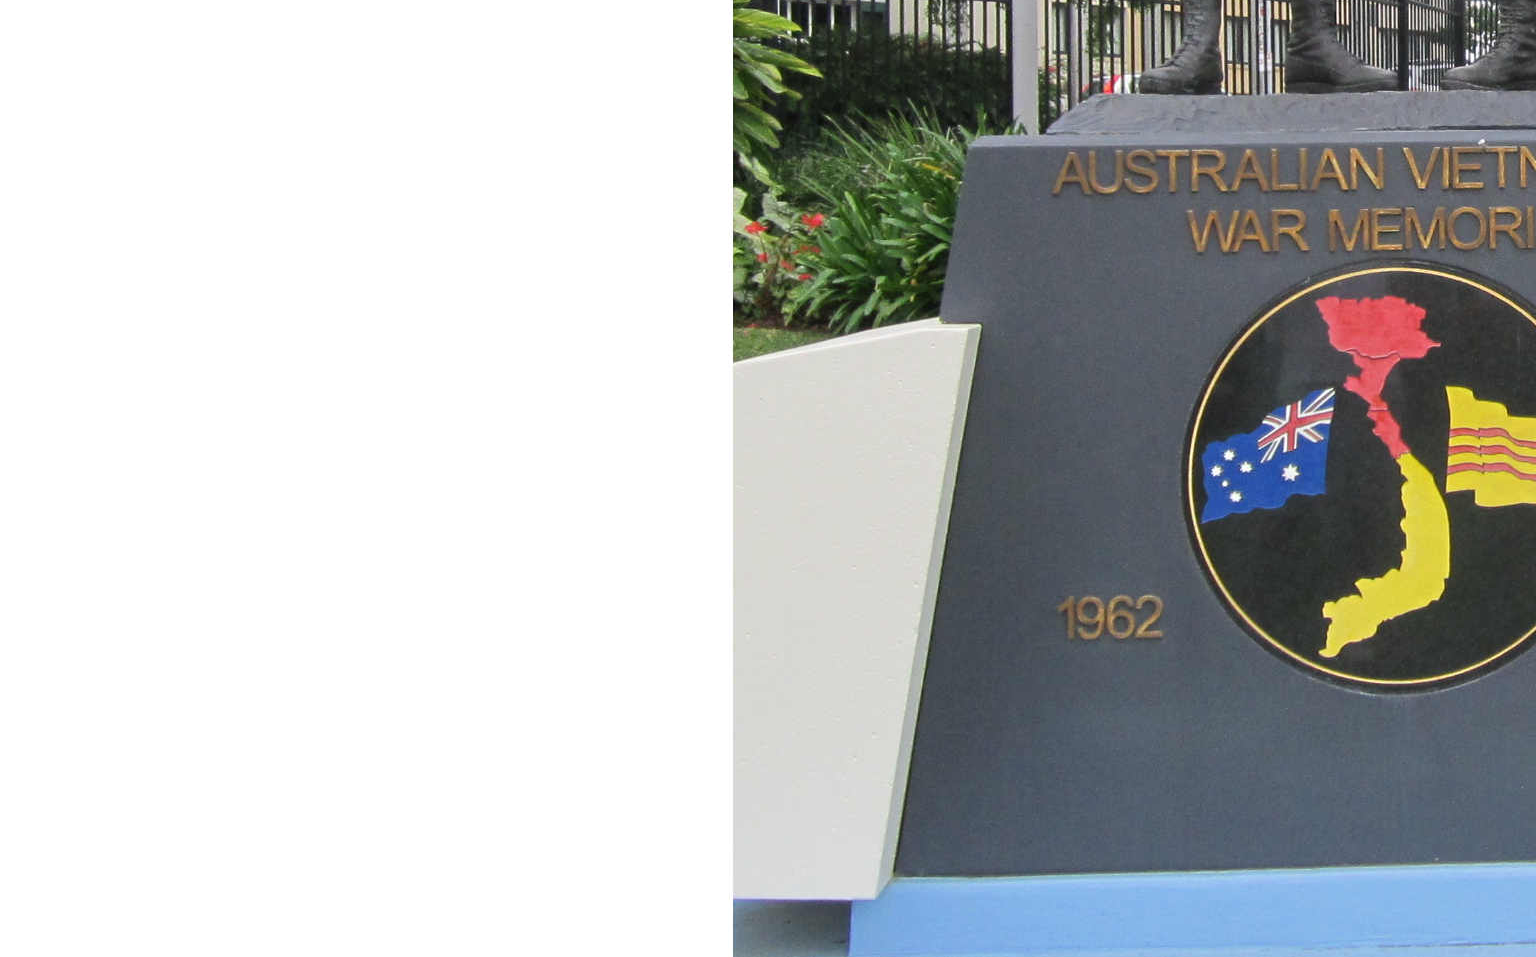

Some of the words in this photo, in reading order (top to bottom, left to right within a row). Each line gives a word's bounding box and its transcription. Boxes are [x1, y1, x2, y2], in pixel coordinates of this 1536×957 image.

[1053, 148, 1385, 194] AUSTRALIAN
[1187, 208, 1310, 253] WAR
[1058, 595, 1164, 640] 1962
